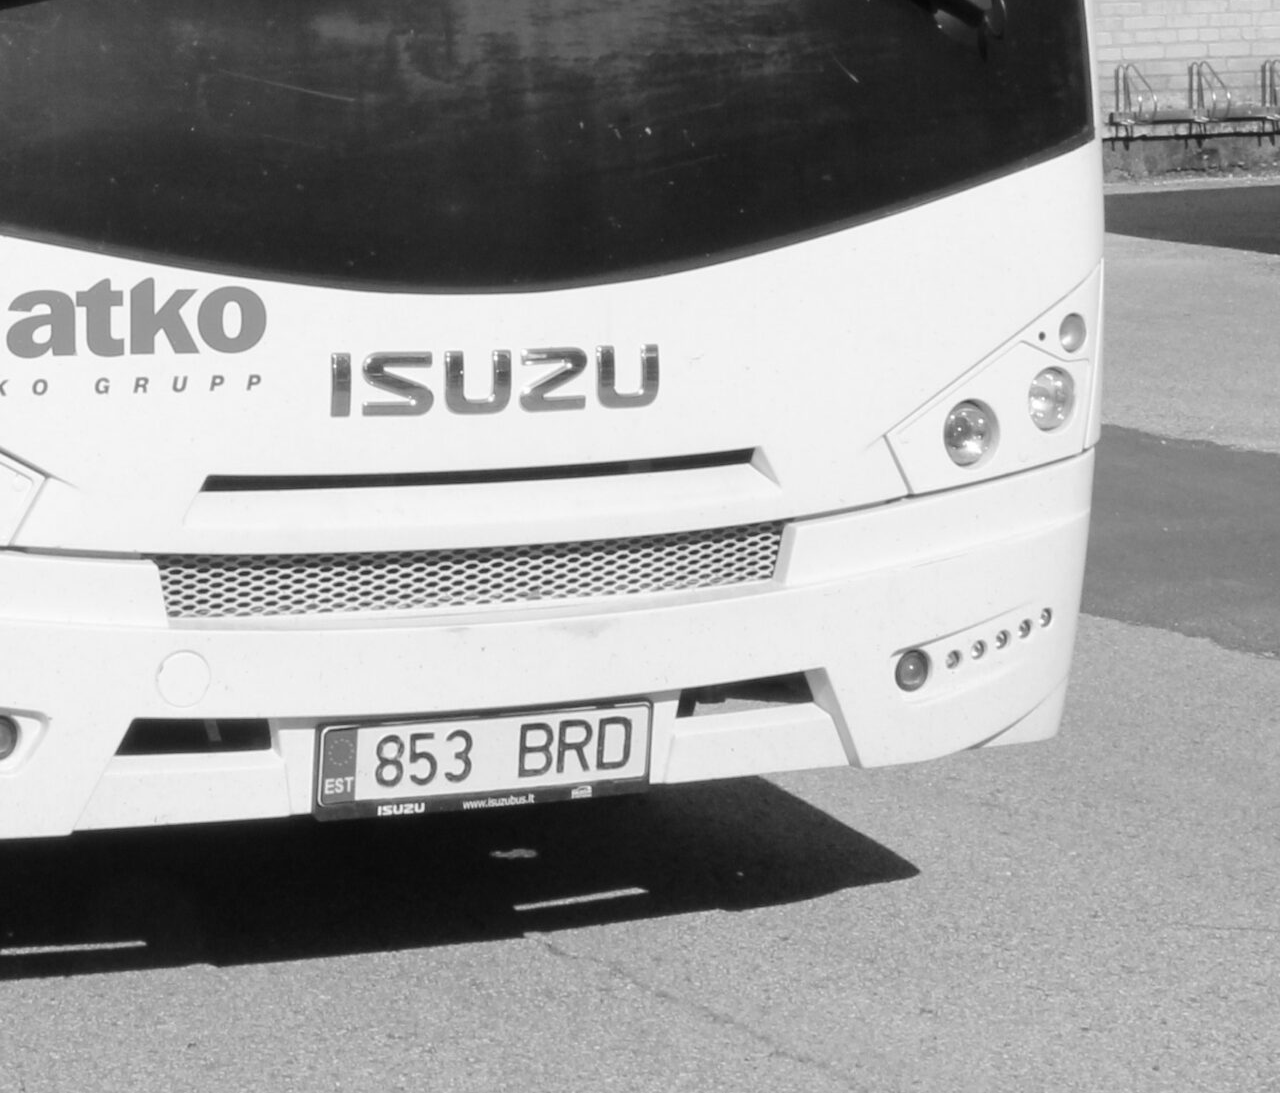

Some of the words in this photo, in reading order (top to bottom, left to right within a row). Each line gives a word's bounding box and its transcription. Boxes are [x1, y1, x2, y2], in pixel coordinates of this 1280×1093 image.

[6, 277, 268, 359] atko
[94, 374, 262, 395] GRUPP
[330, 344, 660, 418] ISUZU
[374, 728, 474, 788] 853
[518, 715, 633, 778] BRD
[324, 775, 354, 795] EST
[377, 802, 426, 817] ISUZU
[462, 793, 536, 811] www.isuzubus.lt
